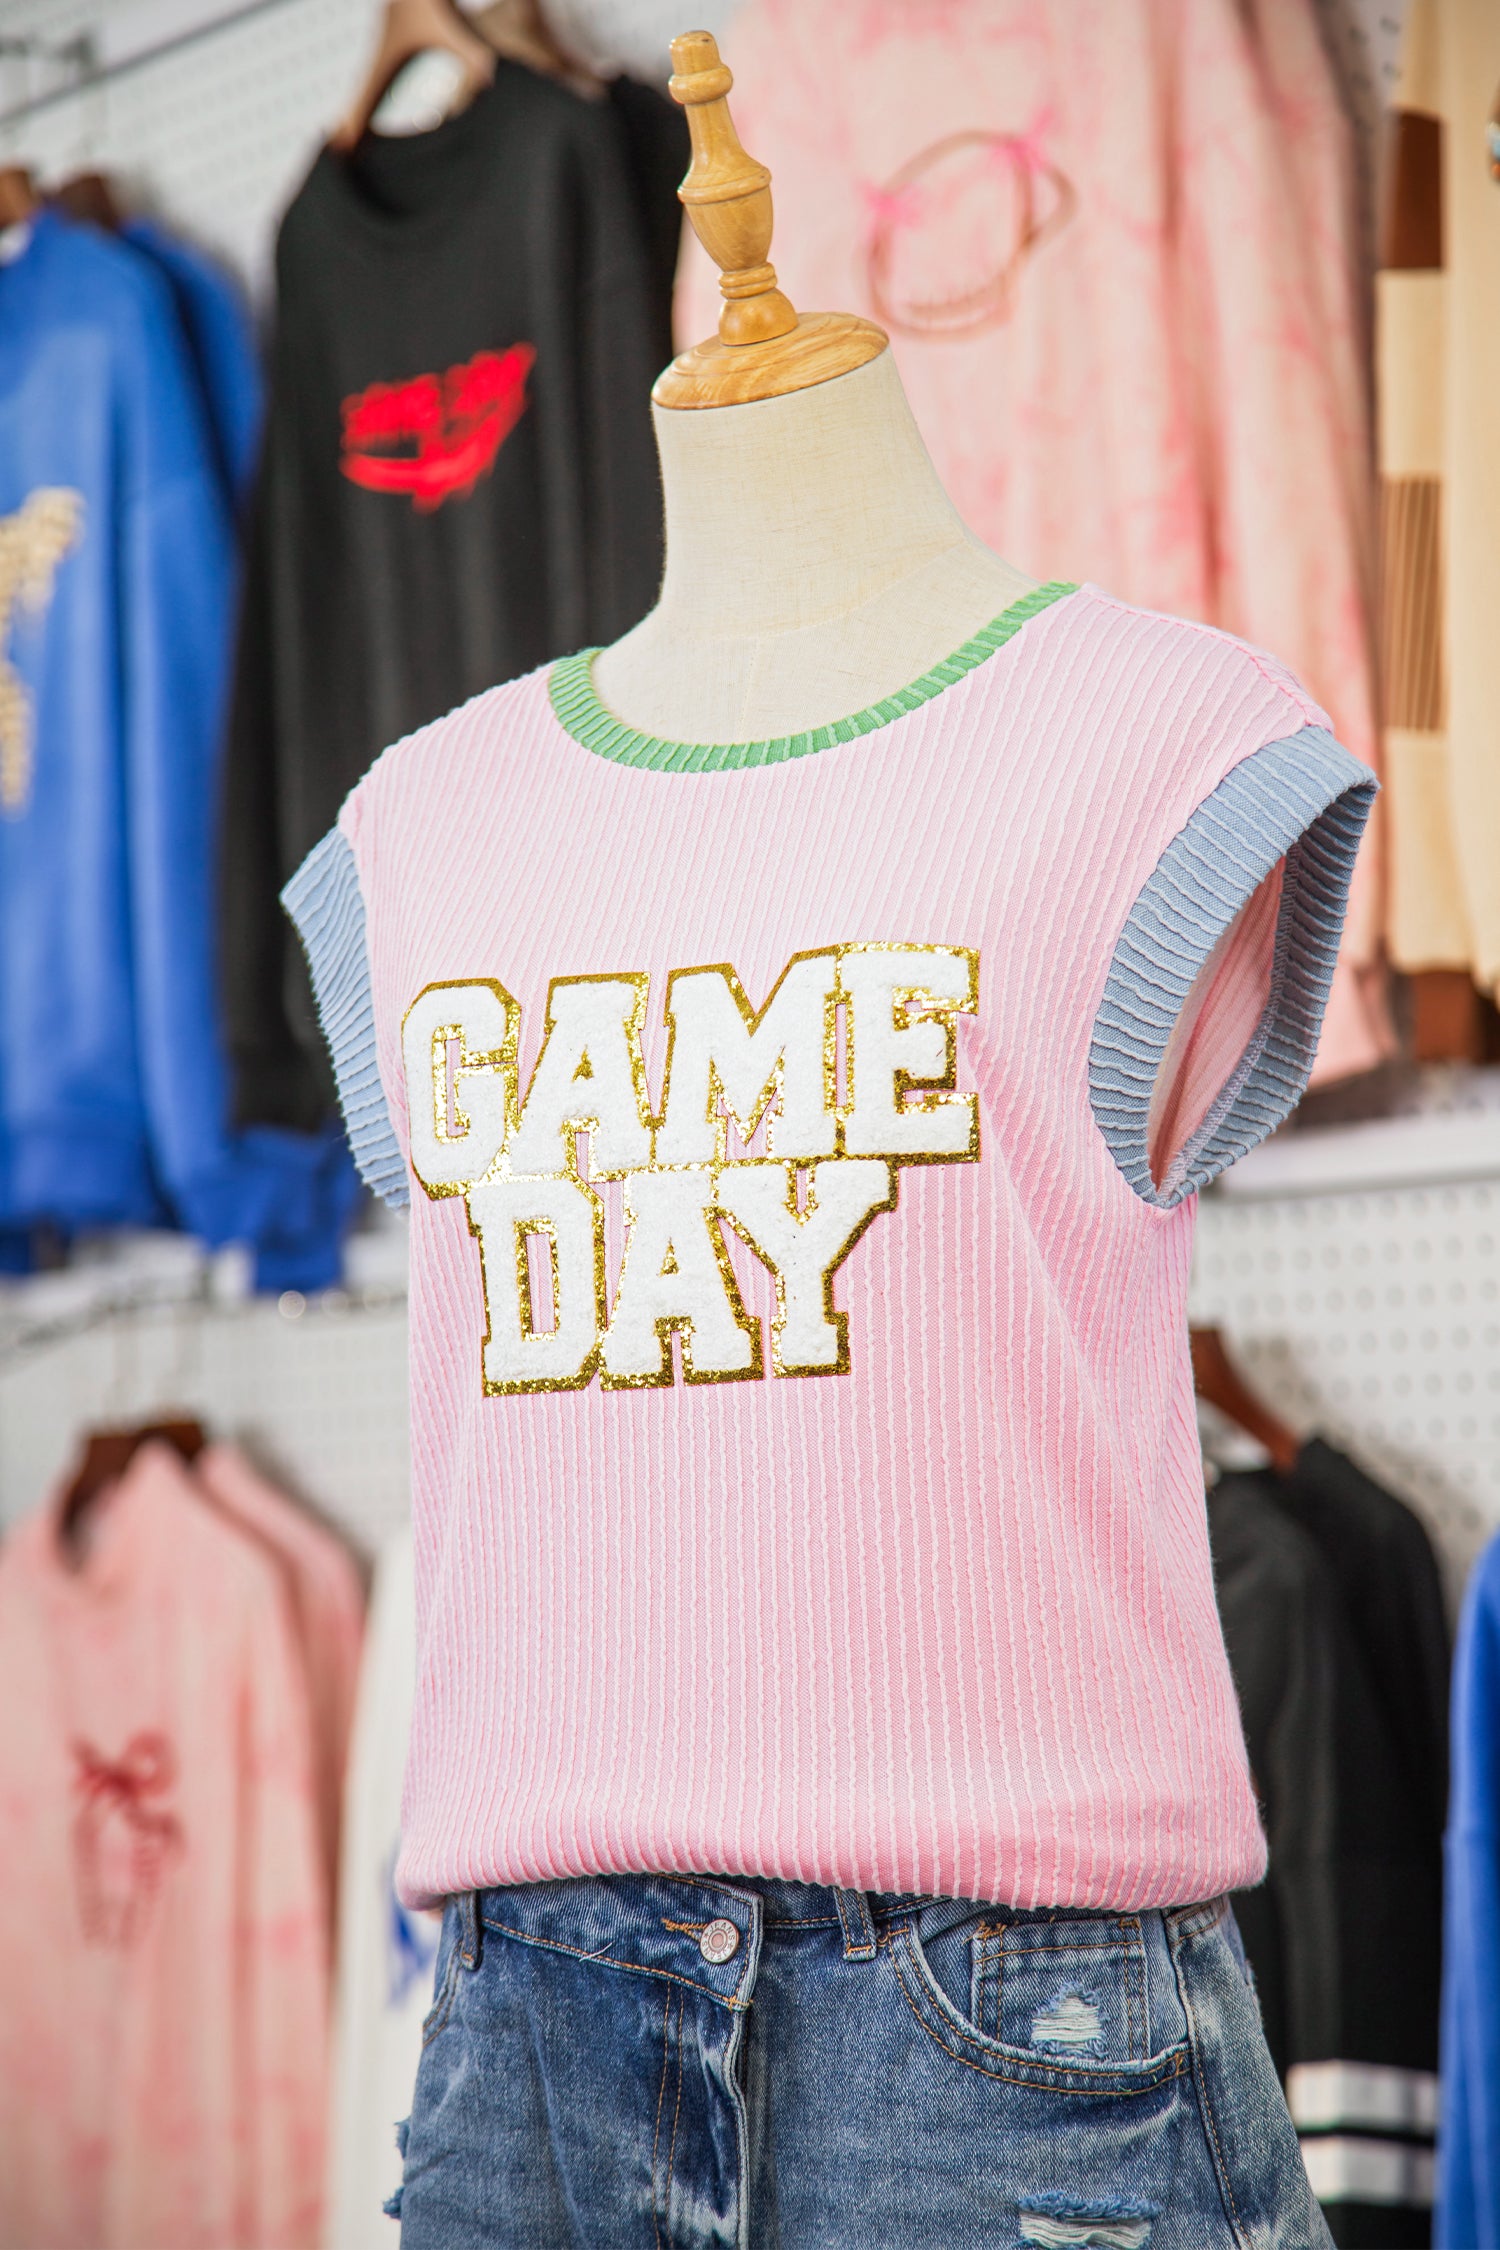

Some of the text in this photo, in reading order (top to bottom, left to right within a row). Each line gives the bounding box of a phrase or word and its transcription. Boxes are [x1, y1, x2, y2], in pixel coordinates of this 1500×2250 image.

[401, 941, 980, 1200] GAME
[466, 1158, 898, 1397] DAY
[710, 1922, 735, 1940] JEANS
